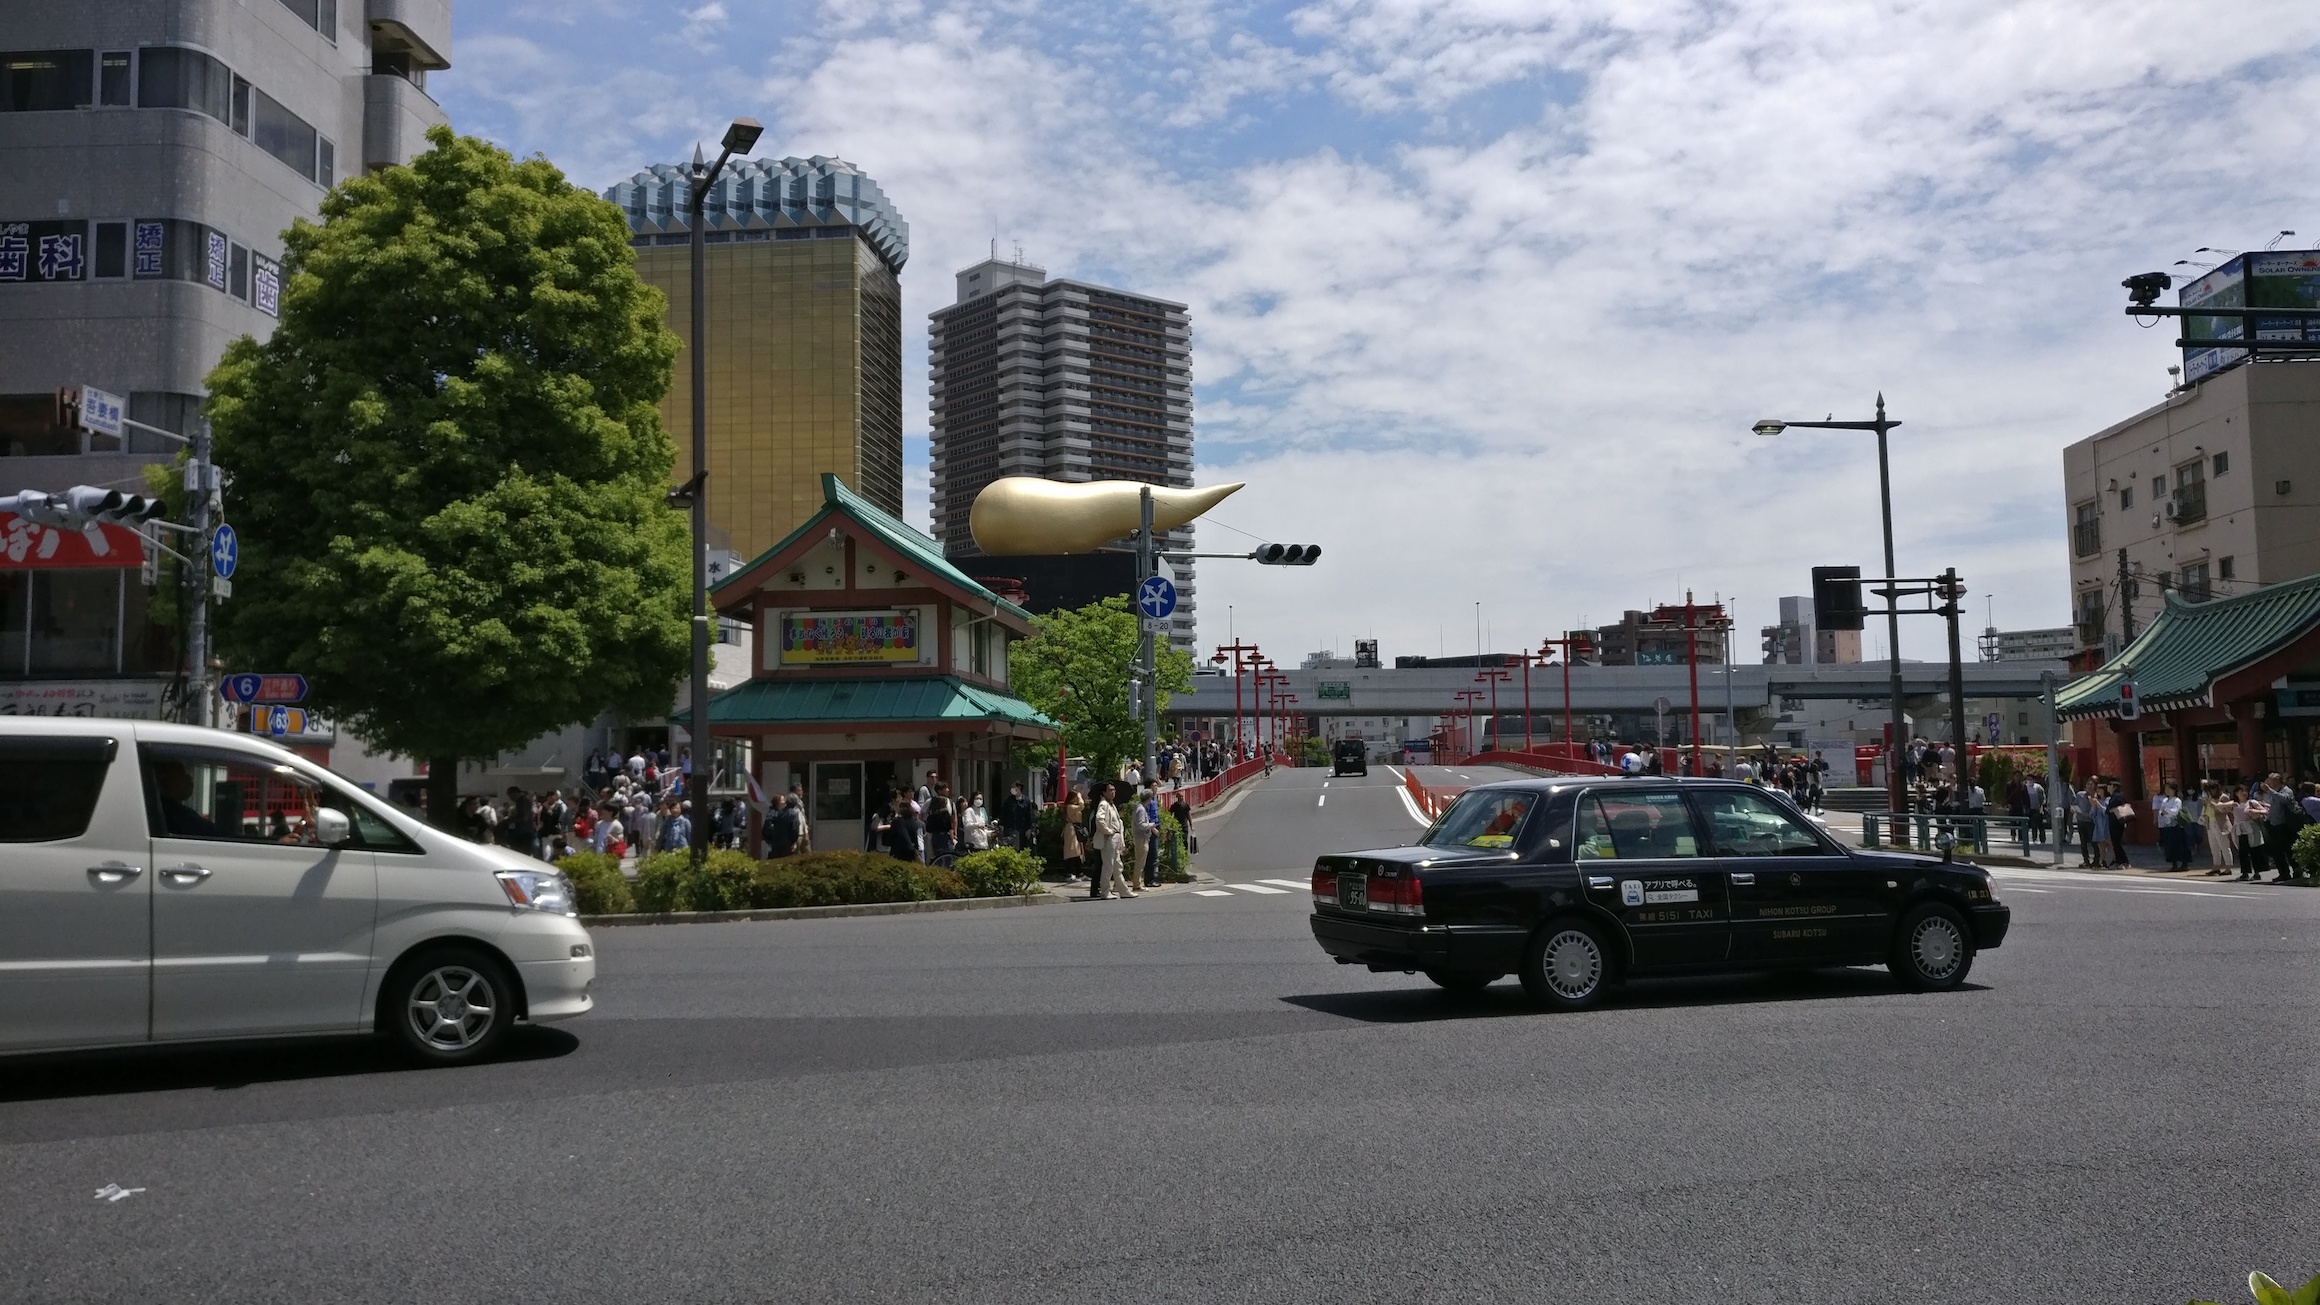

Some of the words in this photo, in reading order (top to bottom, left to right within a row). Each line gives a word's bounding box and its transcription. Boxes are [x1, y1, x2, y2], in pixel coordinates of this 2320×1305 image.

[0, 234, 84, 280] 歯科
[136, 223, 163, 275] 矯正
[208, 231, 225, 289] 矯正
[255, 267, 280, 317] 歯
[86, 398, 119, 422] 吾妻橋
[240, 677, 254, 697] 6
[1645, 879, 1697, 890] アプリで呼べる。
[1688, 909, 1713, 919] TAXI
[1759, 908, 1784, 917] NIHON
[1785, 906, 1809, 915] KOTSU
[1810, 905, 1837, 914] GROUP
[1773, 929, 1800, 939] SUBARU
[1802, 928, 1827, 937] KOTSU
